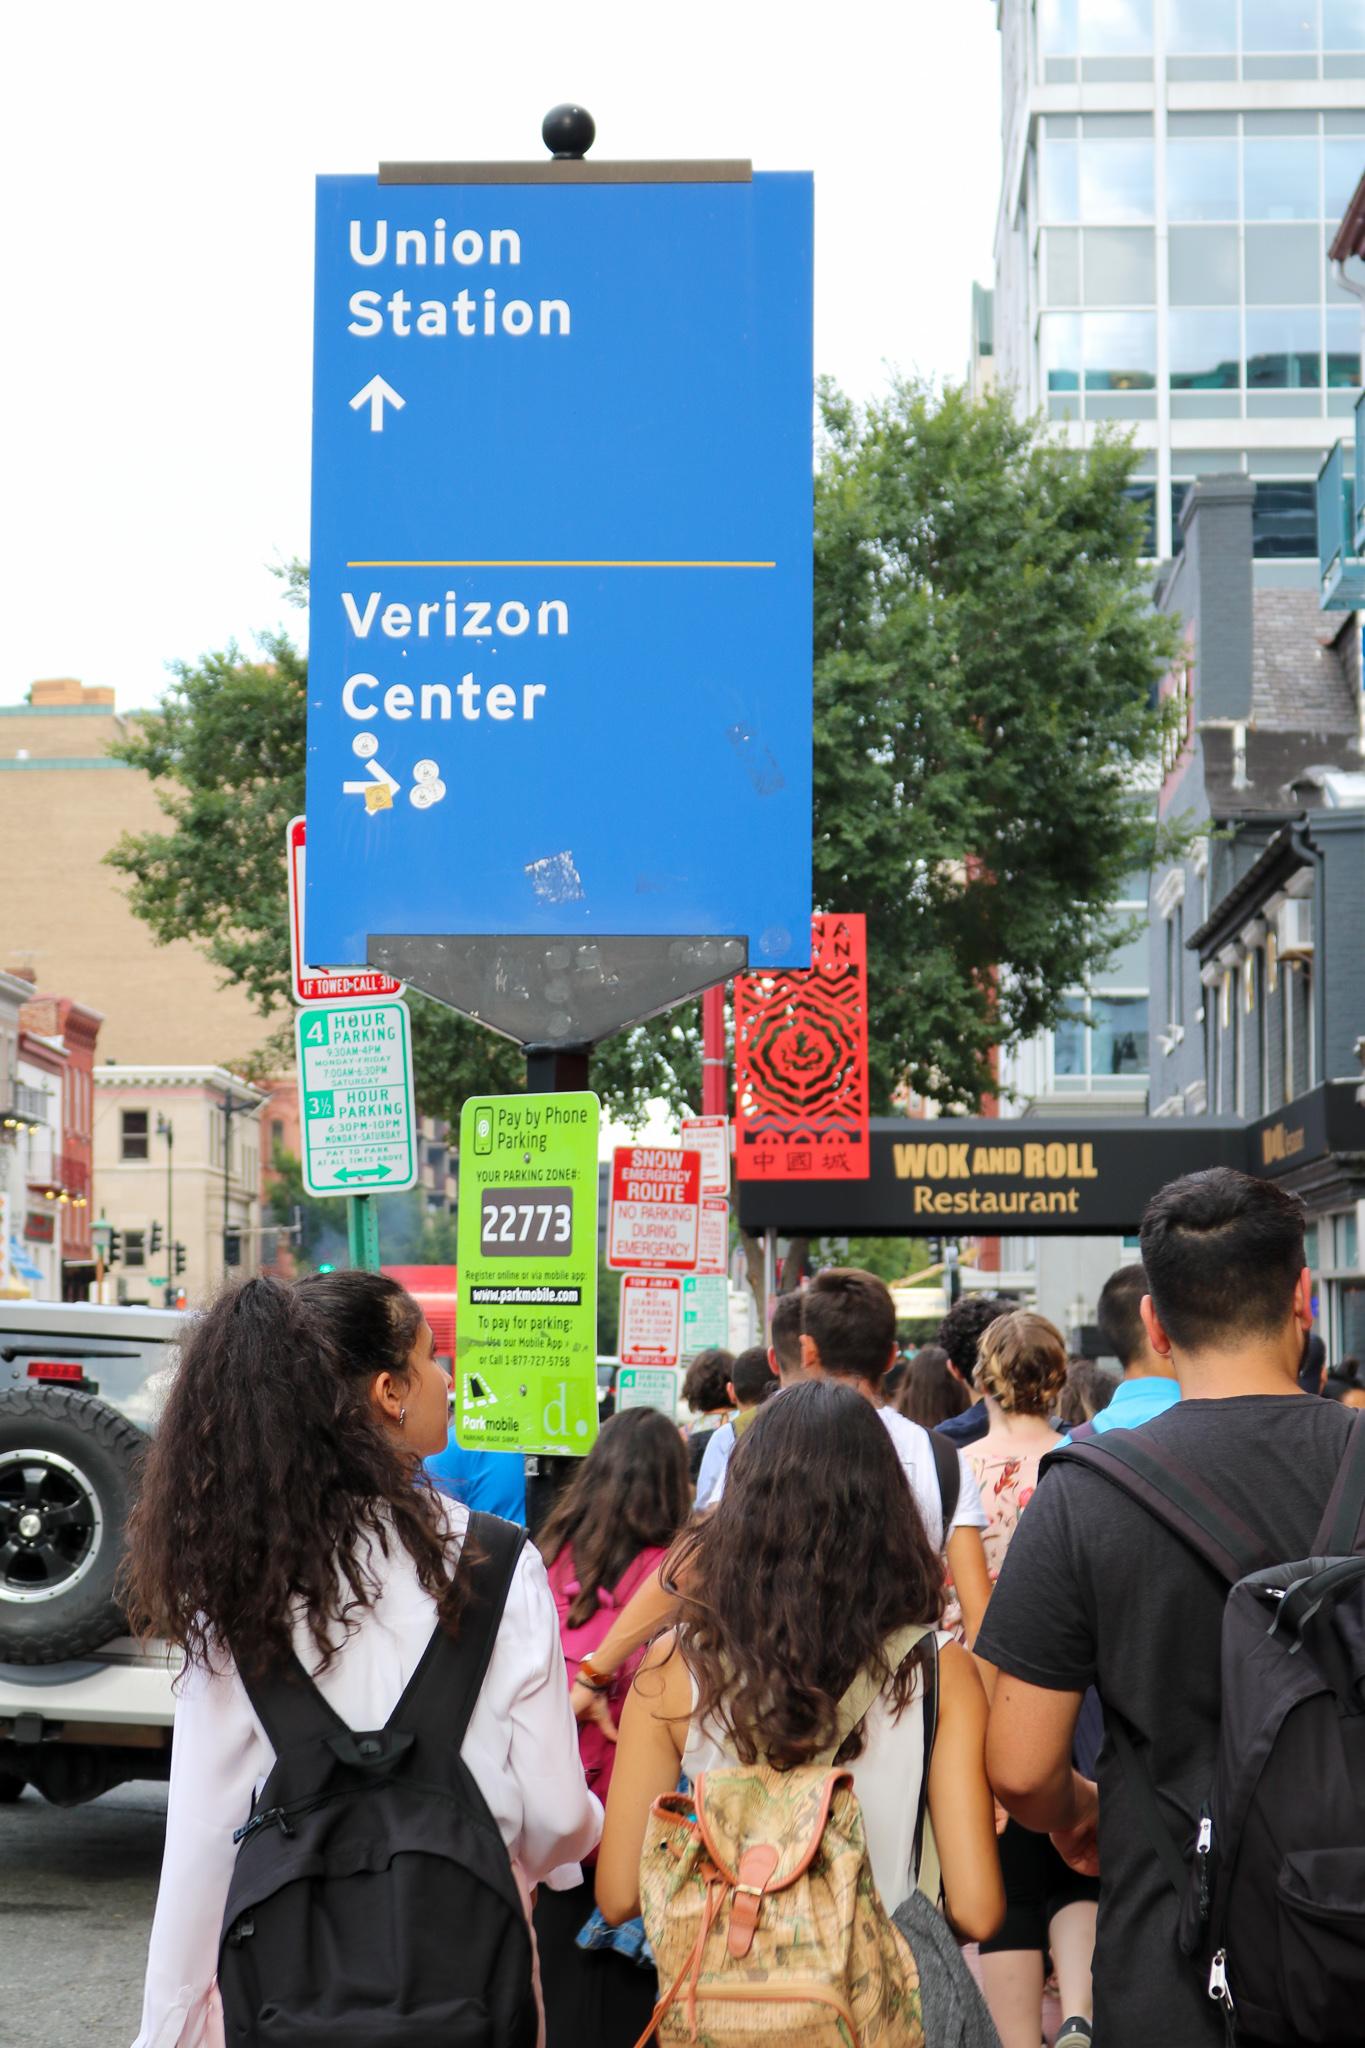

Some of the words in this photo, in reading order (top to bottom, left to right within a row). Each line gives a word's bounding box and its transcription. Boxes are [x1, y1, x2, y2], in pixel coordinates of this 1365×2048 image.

[349, 218, 521, 266] Union
[347, 288, 571, 337] Station
[341, 591, 569, 638] Verizon
[342, 672, 547, 720] Center
[303, 981, 314, 996] IF
[317, 978, 349, 995] TOWED
[353, 975, 377, 992] CALL
[335, 1012, 385, 1029] HOUR
[306, 1020, 324, 1044] 4
[334, 1026, 396, 1045] PARKING
[331, 1077, 379, 1087] SATURDAY
[347, 1089, 389, 1104] HOUR
[339, 1102, 403, 1119] PARKING
[498, 1108, 522, 1130] Pay
[525, 1107, 541, 1130] by
[545, 1106, 588, 1124] Phone
[497, 1131, 547, 1152] Parking
[632, 1149, 684, 1169] SNOW
[752, 1150, 853, 1173] 中國城
[893, 1143, 971, 1179] WOK
[972, 1147, 1021, 1176] AND
[1023, 1142, 1099, 1179] ROLL
[477, 1170, 503, 1183] YOUR
[503, 1169, 543, 1182] PARKING
[621, 1167, 692, 1183] EMERGENCY
[626, 1181, 686, 1202] ROUTE
[914, 1184, 1080, 1214] Restaurant
[618, 1204, 637, 1220] NO
[640, 1205, 693, 1222] PARKING
[482, 1204, 571, 1242] 22773
[631, 1223, 677, 1239] DURING
[616, 1239, 689, 1257] EMERGENCY
[465, 1269, 496, 1282] Register
[497, 1270, 520, 1280] online
[531, 1270, 543, 1280] via
[544, 1269, 569, 1280] mobile
[472, 1286, 579, 1305] www.parkmobile.com
[478, 1315, 490, 1329] To
[492, 1317, 510, 1332] pay
[513, 1315, 527, 1329] for
[504, 1338, 518, 1348] our
[519, 1336, 545, 1348] Mobile
[547, 1337, 562, 1350] App
[480, 1356, 489, 1366] or
[489, 1354, 503, 1366] Call
[623, 1373, 635, 1387] 4
[463, 1415, 520, 1432] Parkmobile
